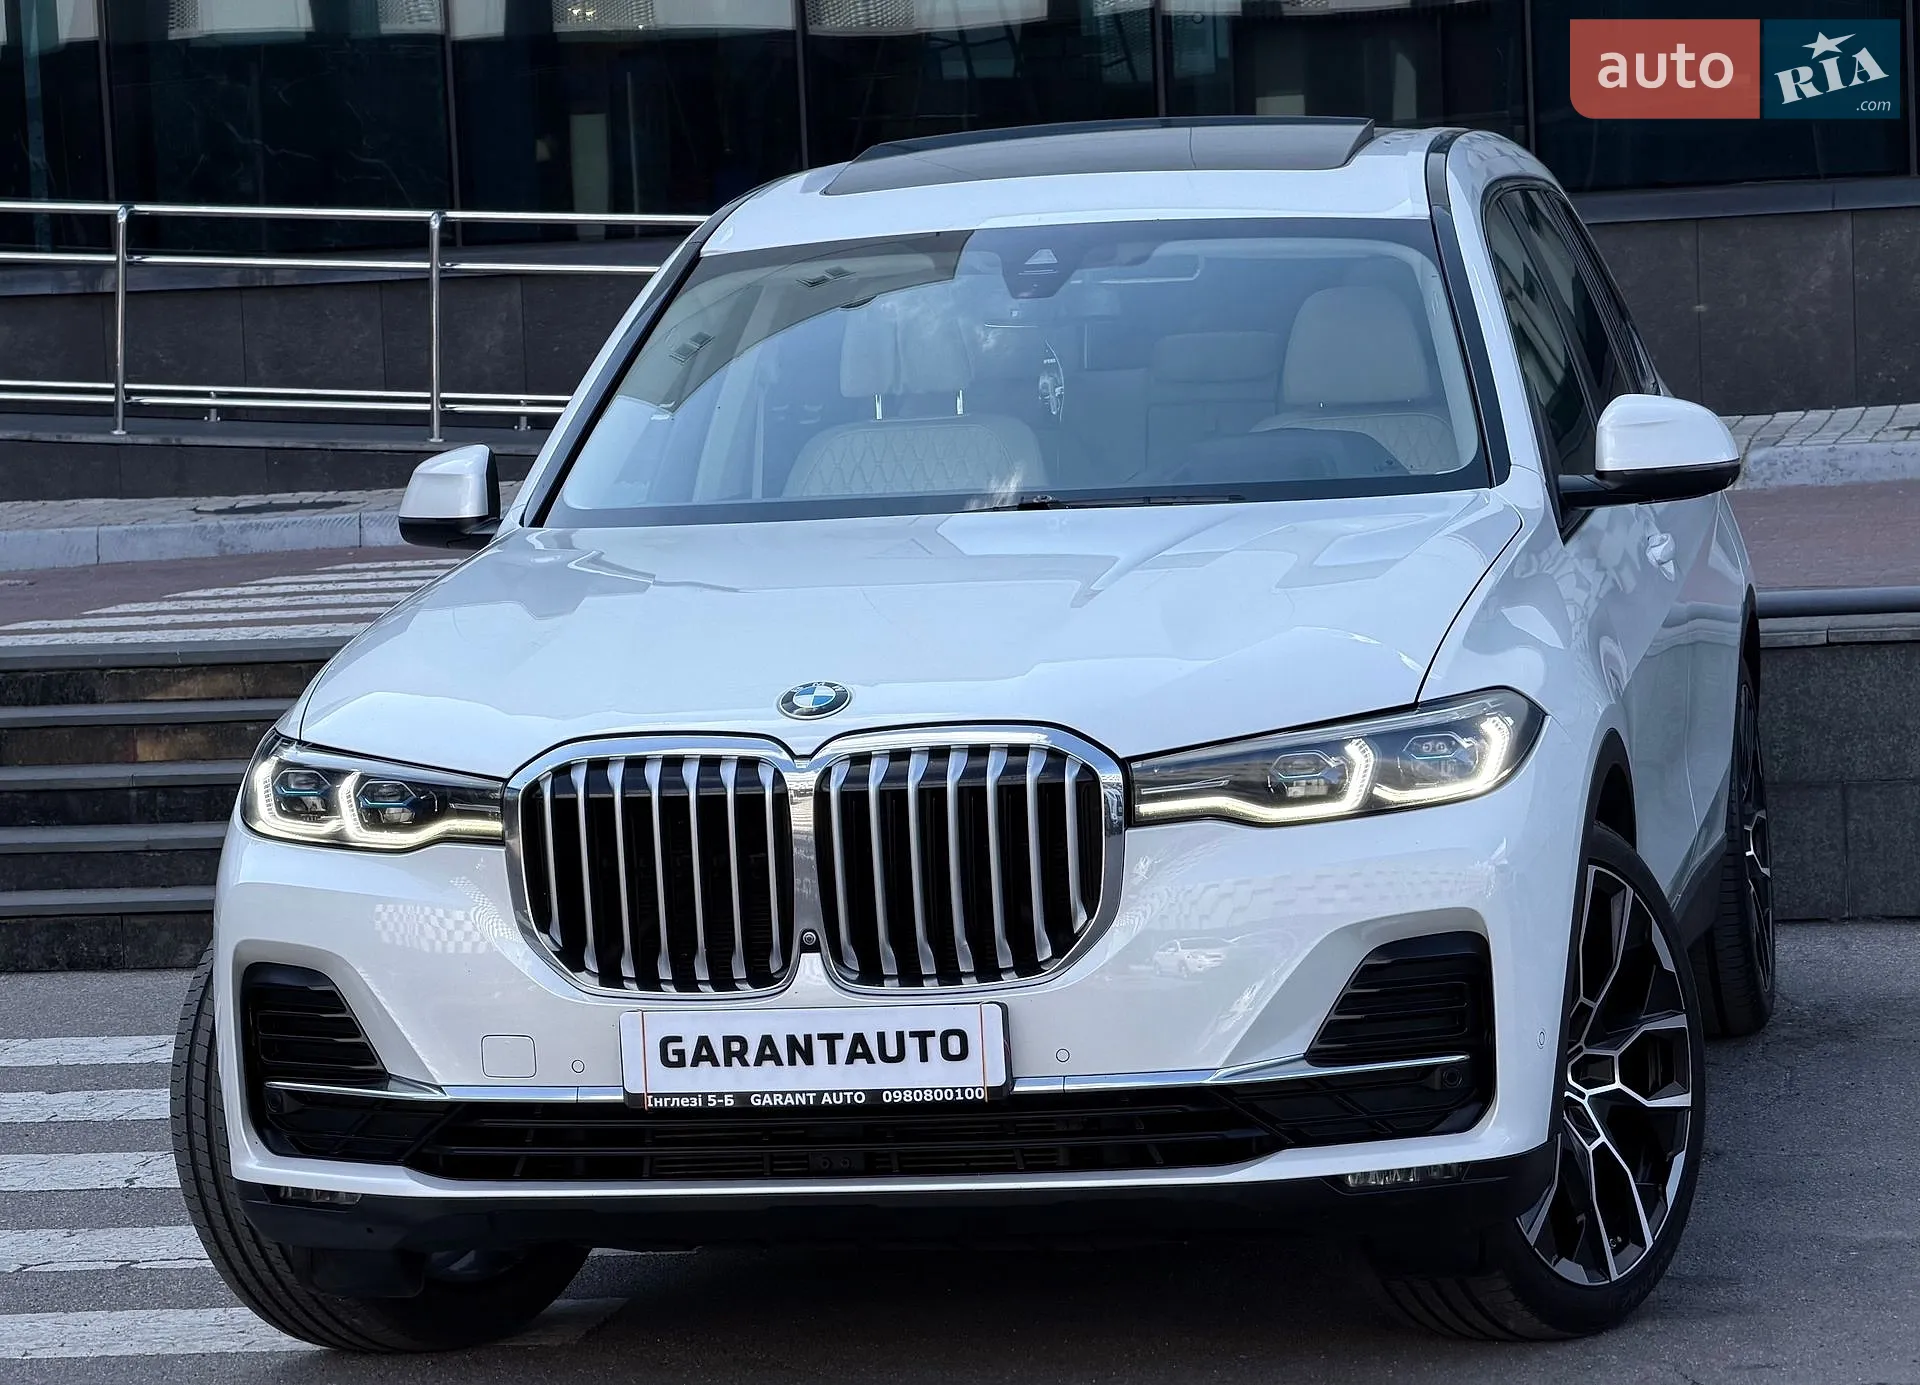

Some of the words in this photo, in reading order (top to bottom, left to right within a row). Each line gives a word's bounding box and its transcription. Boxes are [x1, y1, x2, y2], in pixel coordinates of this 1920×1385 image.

[658, 1028, 970, 1069] GARANTAUTO
[707, 1094, 735, 1107] 5-Б
[750, 1093, 817, 1106] GARANT
[821, 1091, 866, 1105] AUTO
[882, 1087, 985, 1103] 0980800100
